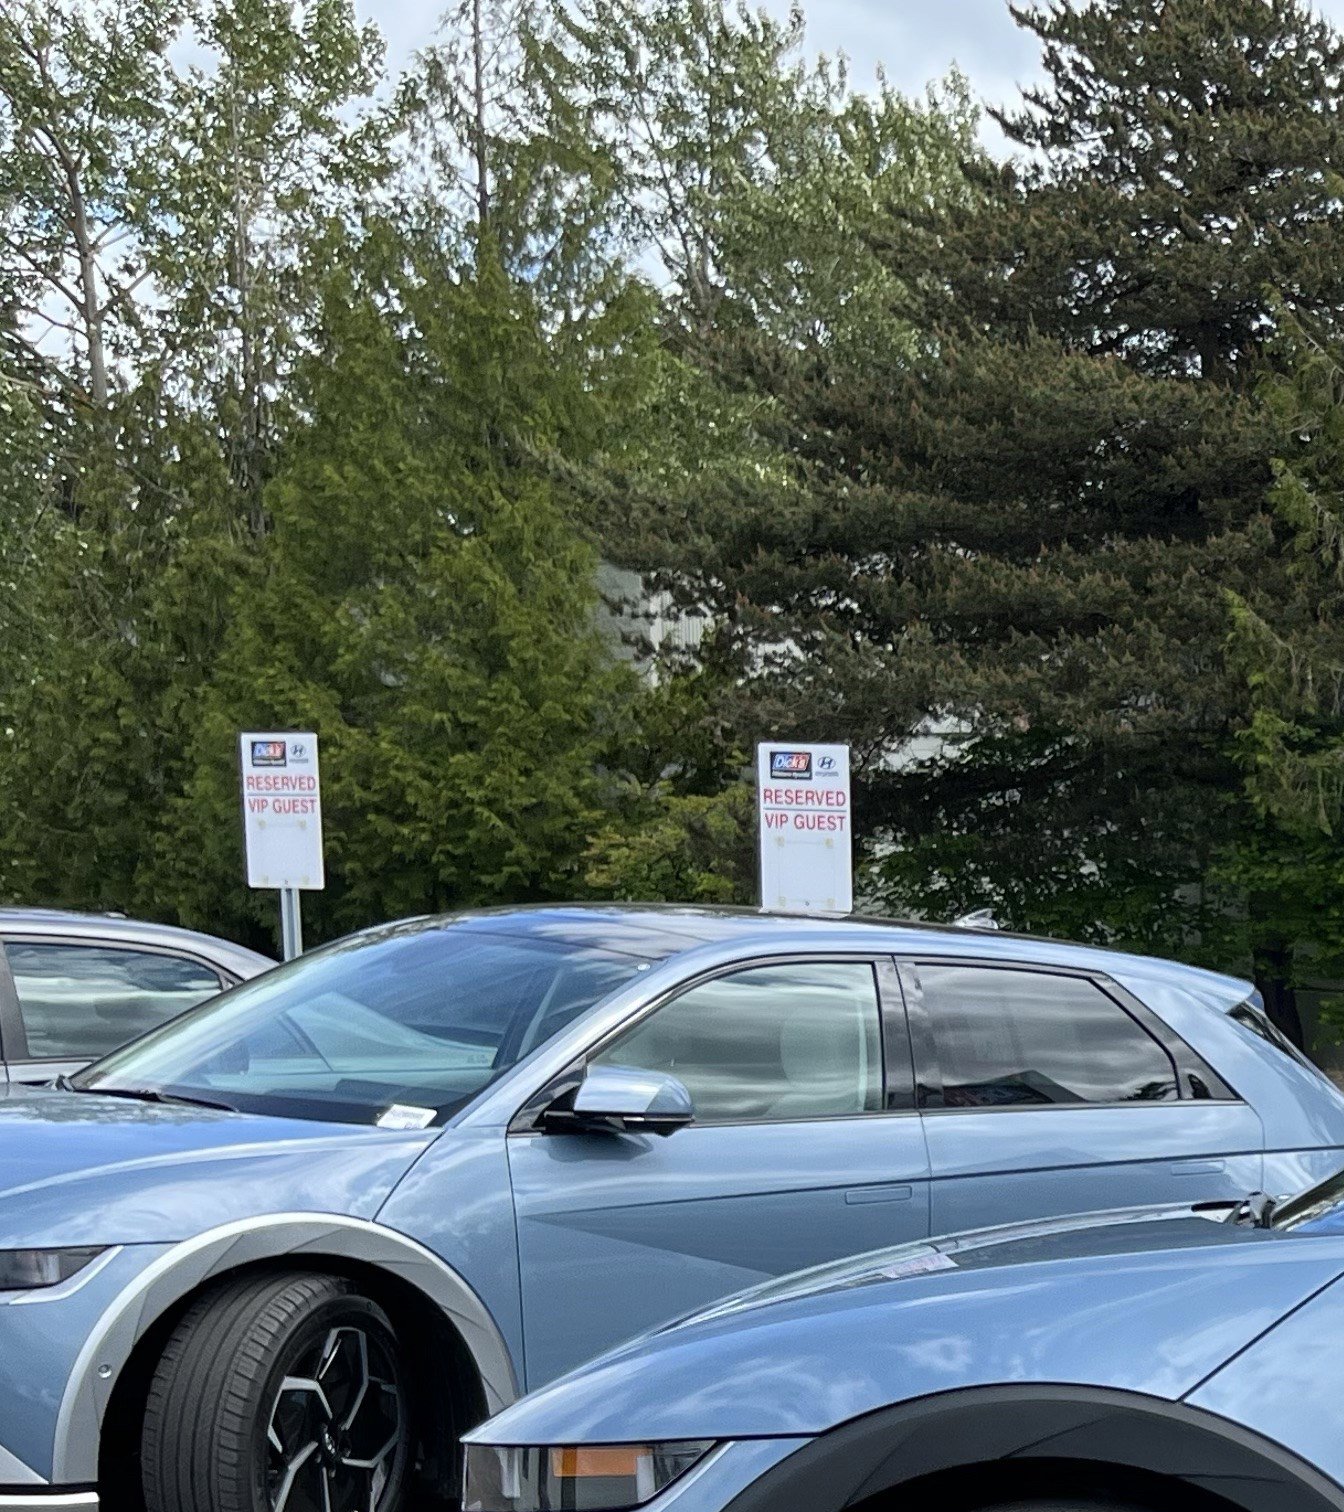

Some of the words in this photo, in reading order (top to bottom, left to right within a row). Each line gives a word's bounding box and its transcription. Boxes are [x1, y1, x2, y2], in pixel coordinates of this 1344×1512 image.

[246, 775, 317, 791] RESERVED
[248, 798, 269, 814] VIP
[272, 798, 318, 814] GUEST
[763, 788, 847, 807] RESERVED
[764, 813, 789, 830] VIP
[793, 814, 847, 832] GUEST
